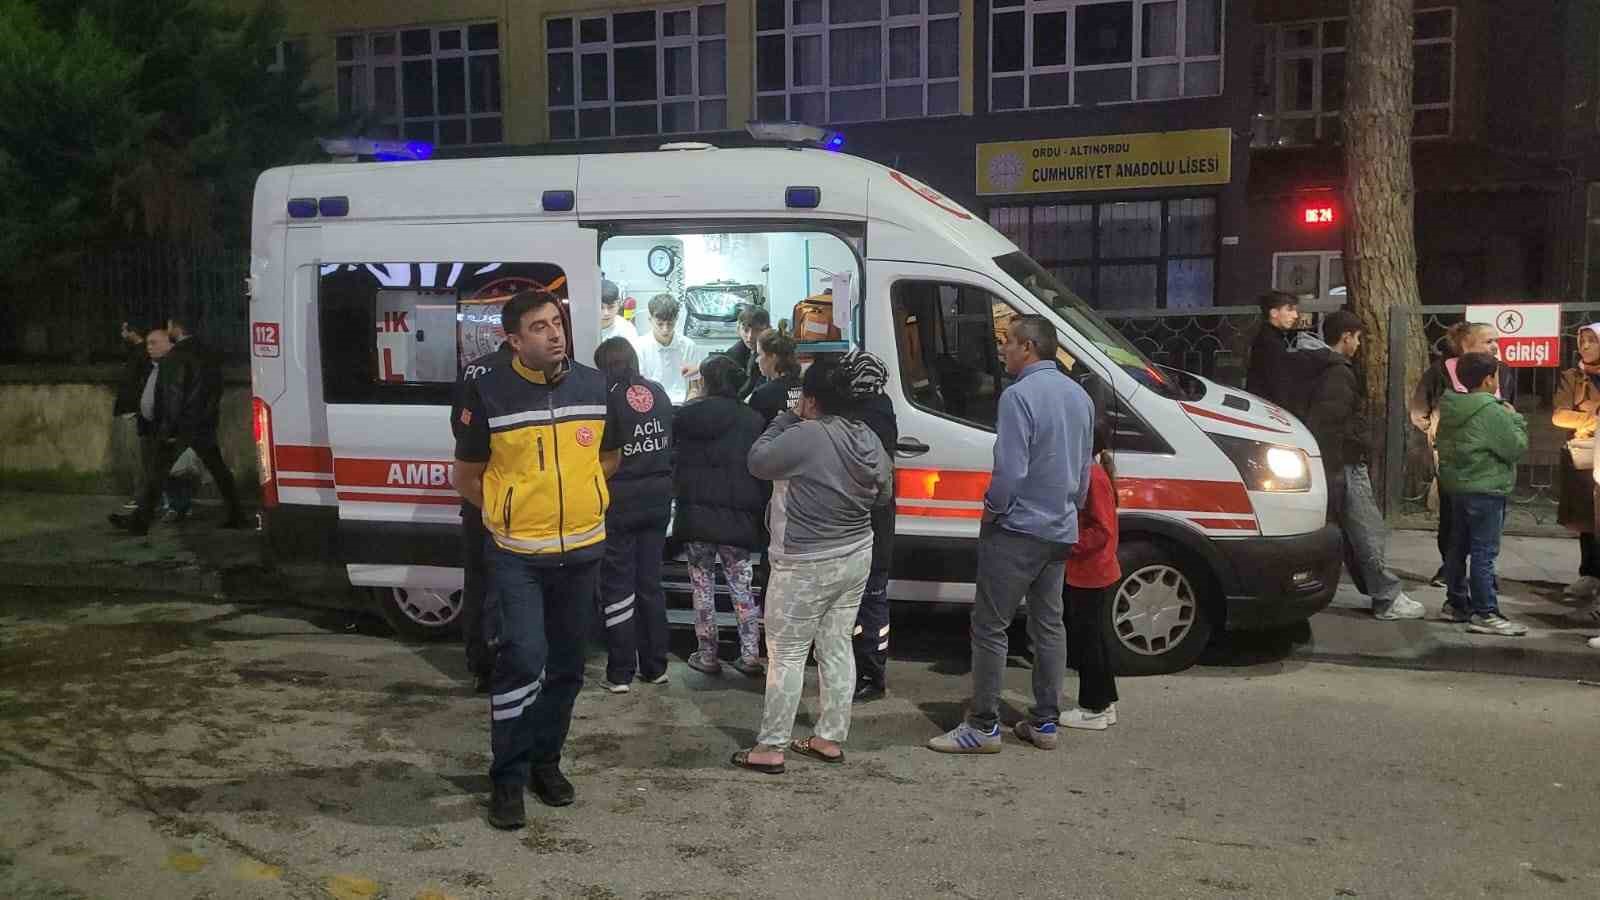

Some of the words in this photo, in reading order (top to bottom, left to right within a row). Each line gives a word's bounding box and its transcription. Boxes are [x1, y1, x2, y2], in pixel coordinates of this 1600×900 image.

[1032, 147, 1060, 158] ORDU
[1070, 143, 1130, 156] ALTINORDU
[1032, 164, 1112, 182] CUMHURİYET
[1116, 161, 1175, 177] ANADOLU
[1179, 152, 1219, 174] LİSESİ
[256, 326, 275, 343] 112
[1505, 341, 1550, 365] GİRİŞİ
[633, 418, 665, 437] ACİL
